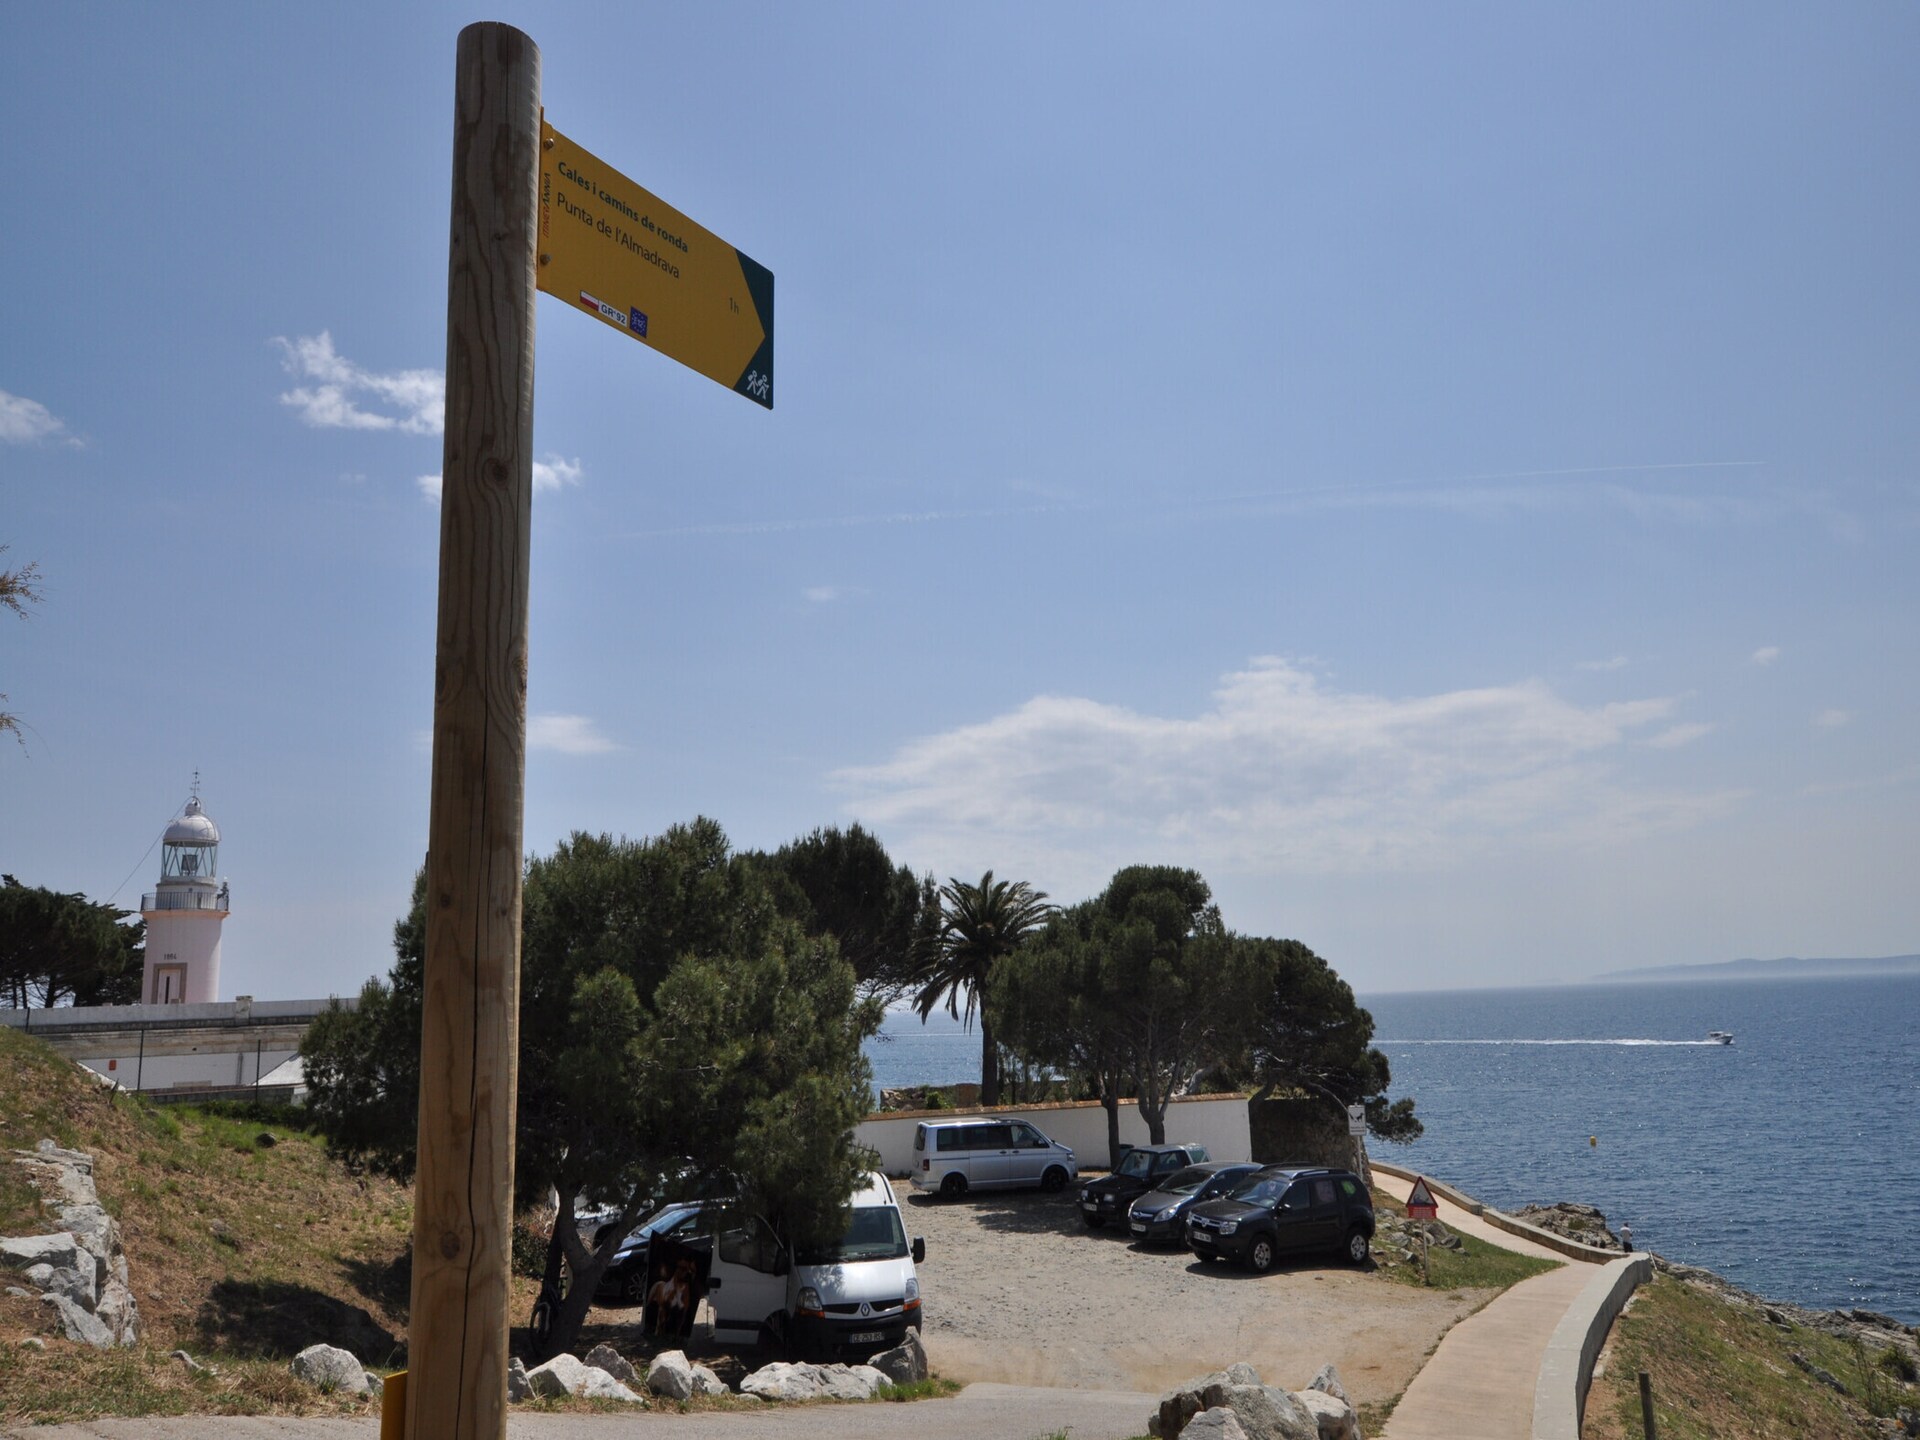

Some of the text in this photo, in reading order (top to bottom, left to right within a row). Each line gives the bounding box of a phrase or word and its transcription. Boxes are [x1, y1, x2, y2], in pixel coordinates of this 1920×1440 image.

[557, 192, 680, 279] Punta de l'Almadrava
[558, 161, 688, 253] Cales i camins de ronda
